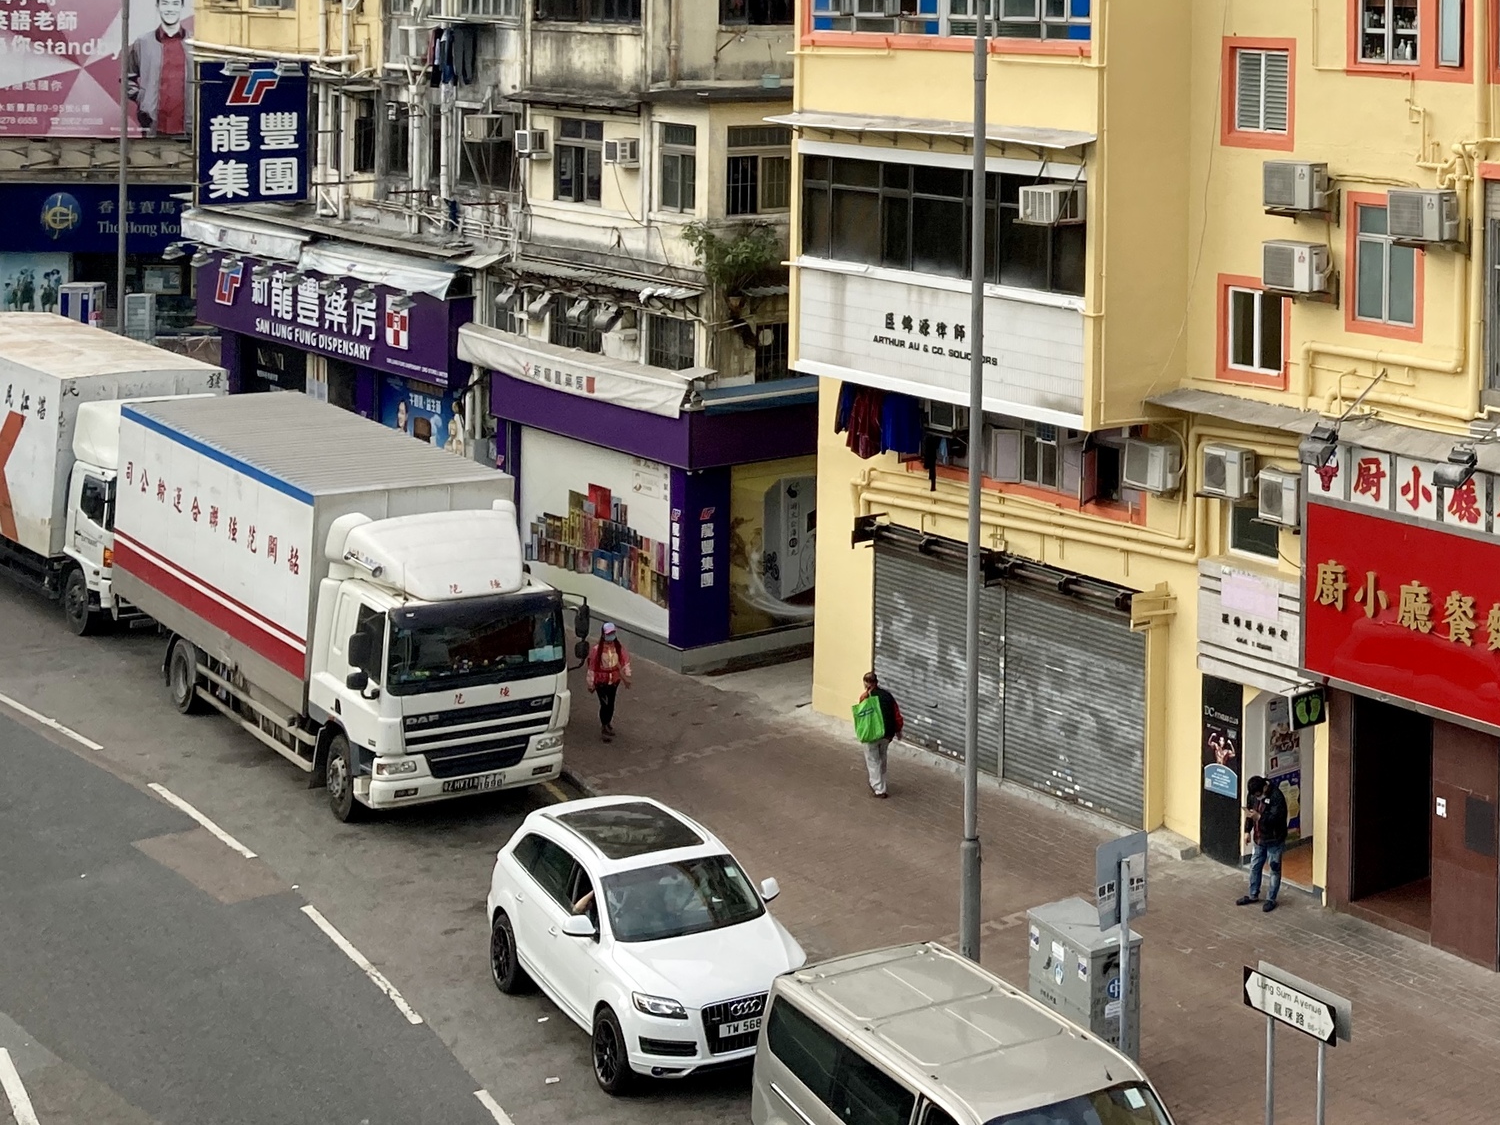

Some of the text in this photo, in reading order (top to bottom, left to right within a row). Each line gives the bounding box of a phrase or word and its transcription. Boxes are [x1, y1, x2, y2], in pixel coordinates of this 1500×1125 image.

[210, 112, 299, 152] 龍豐
[208, 157, 298, 198] 集團
[256, 318, 371, 361] SAN LUNG FUNG DISPENSARY
[885, 312, 984, 343] 區錦源律師
[873, 335, 906, 349] ARTHUR
[908, 342, 920, 351] AU
[931, 346, 946, 357] CO.
[948, 349, 998, 366] SOLICORS
[405, 715, 440, 725] DAF
[1256, 977, 1322, 1016] Lung Sum Avenue
[726, 1018, 762, 1034] TW 568
